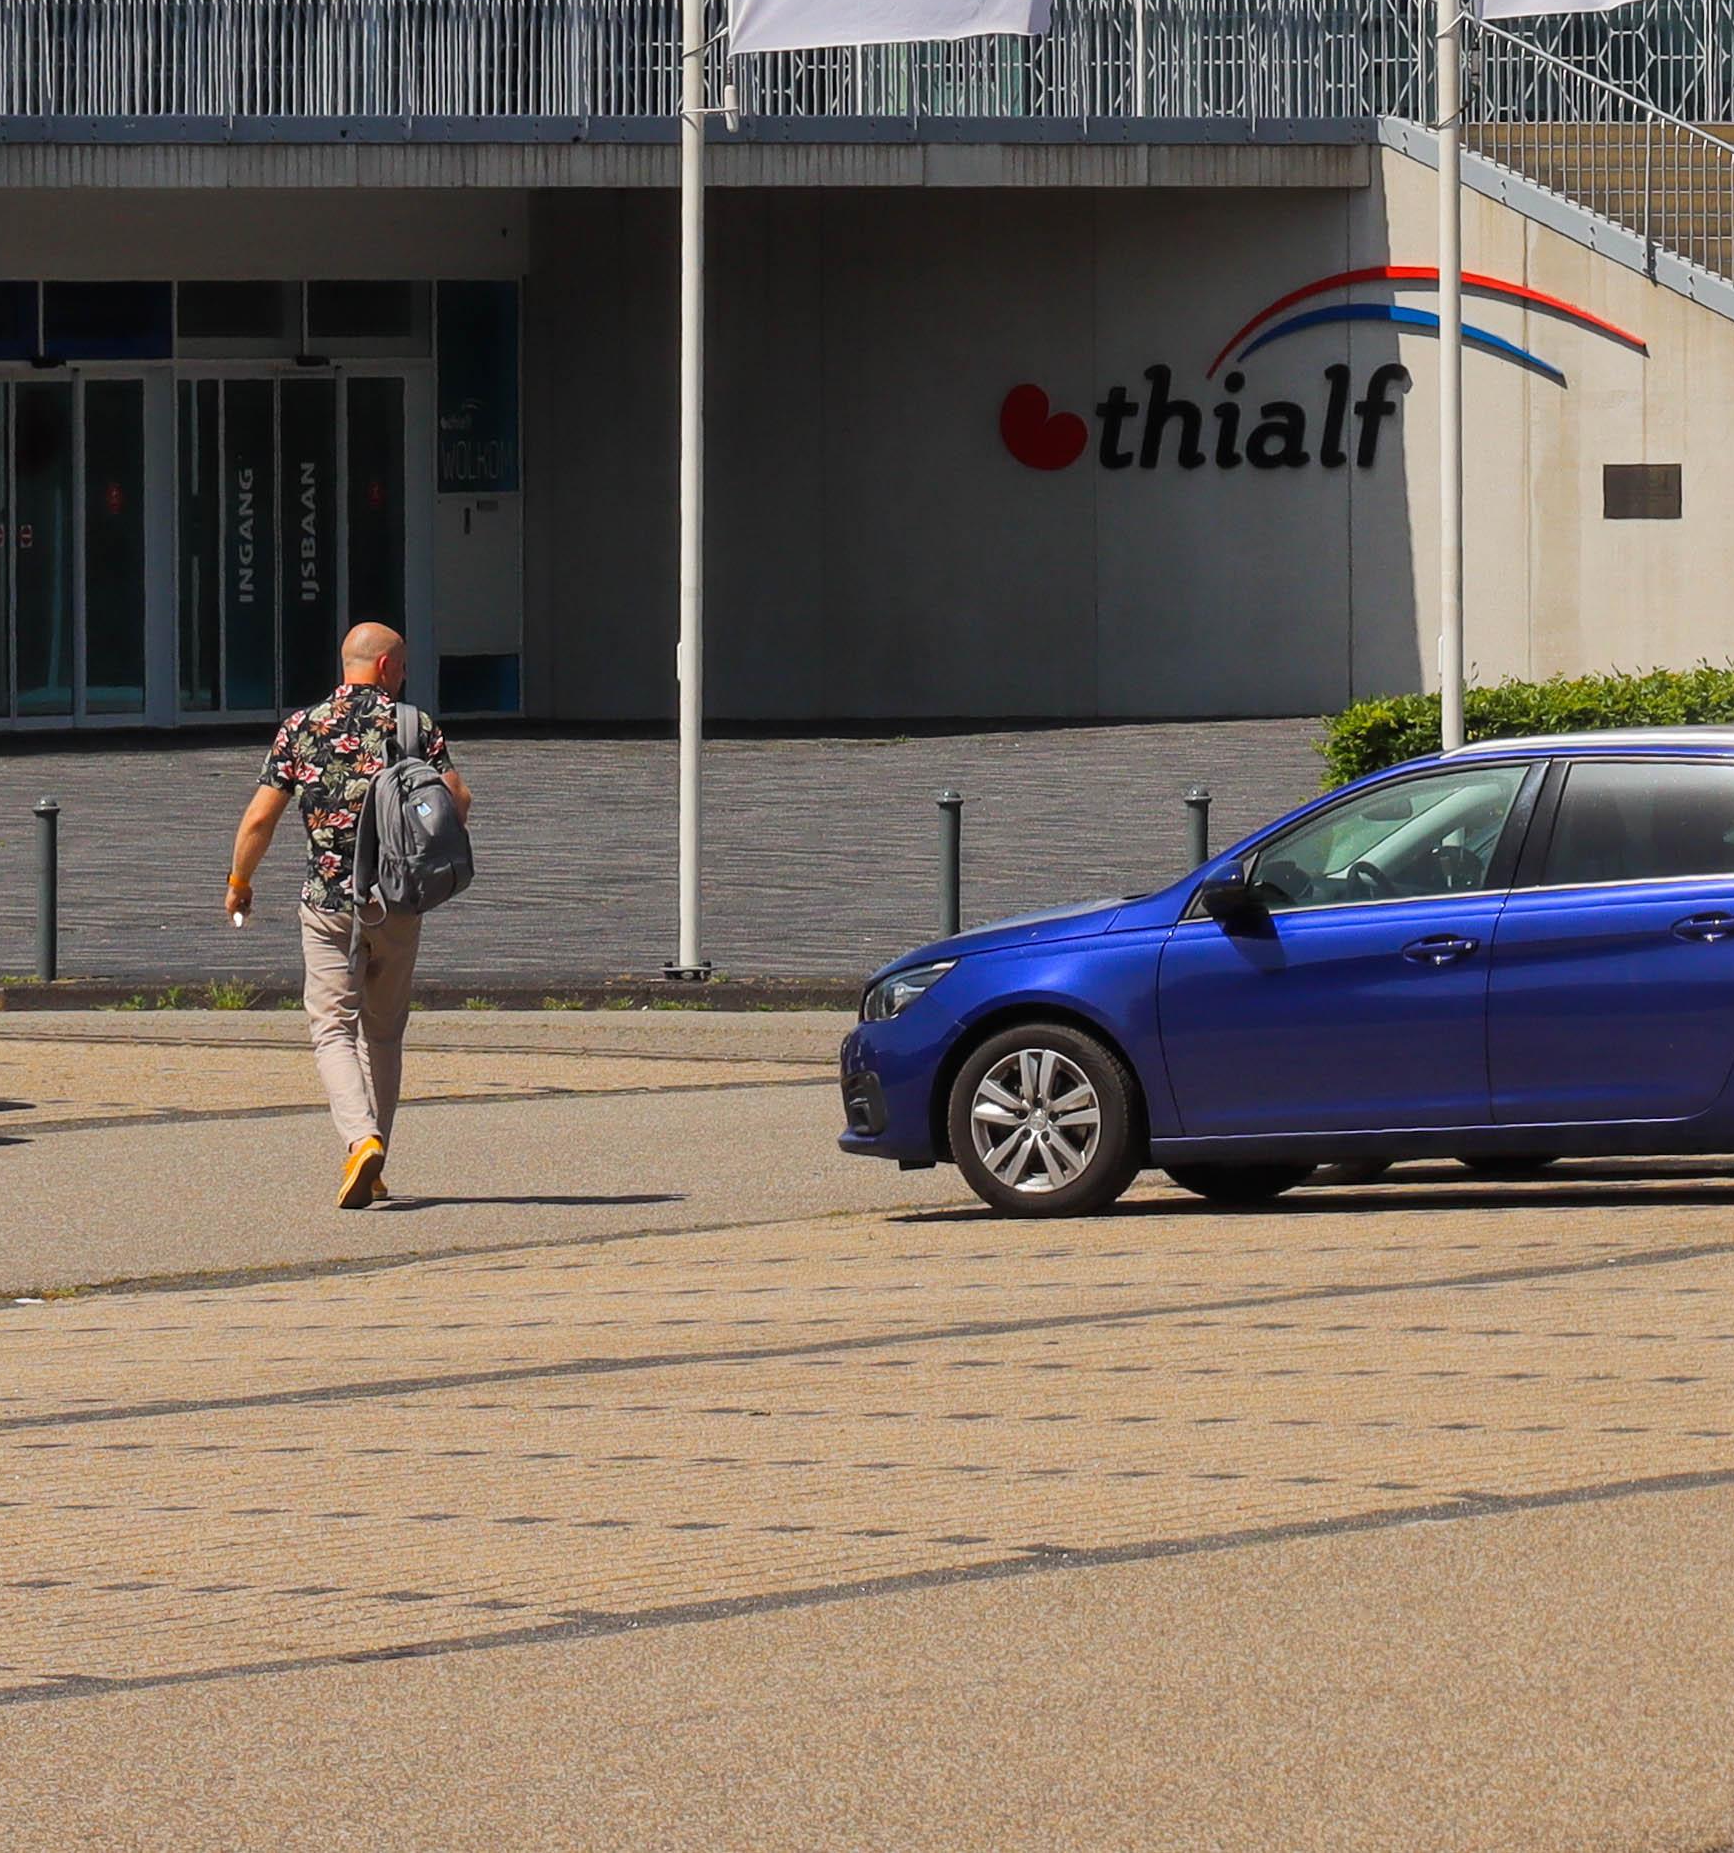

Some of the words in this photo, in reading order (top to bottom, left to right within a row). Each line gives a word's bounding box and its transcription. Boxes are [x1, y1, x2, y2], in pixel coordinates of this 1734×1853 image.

[1095, 363, 1414, 470] thialf
[238, 467, 254, 603] INGANG
[300, 462, 320, 601] IJSBAAN
